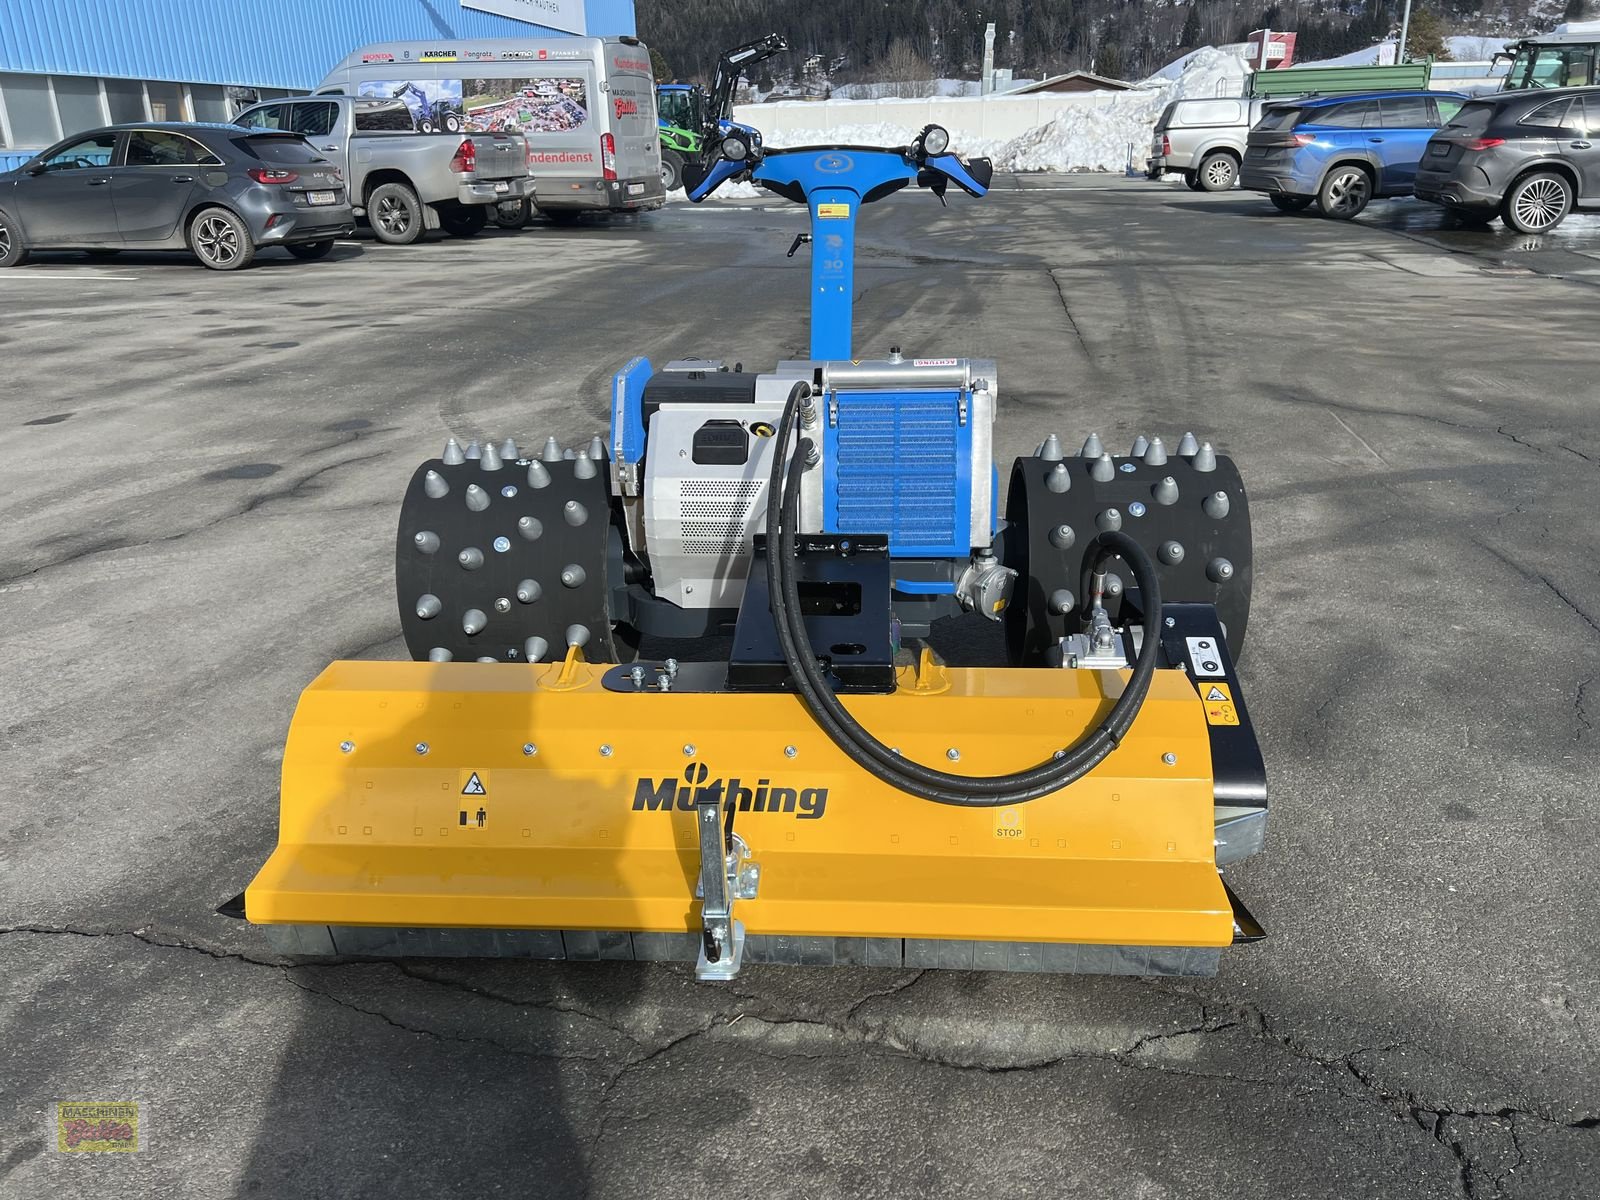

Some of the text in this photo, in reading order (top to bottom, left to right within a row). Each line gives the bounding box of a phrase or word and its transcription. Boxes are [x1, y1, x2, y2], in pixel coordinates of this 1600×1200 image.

[424, 50, 457, 58] KÄRCHER
[530, 152, 593, 163] ndendienst
[823, 259, 844, 270] 30
[997, 828, 1022, 837] STOP
